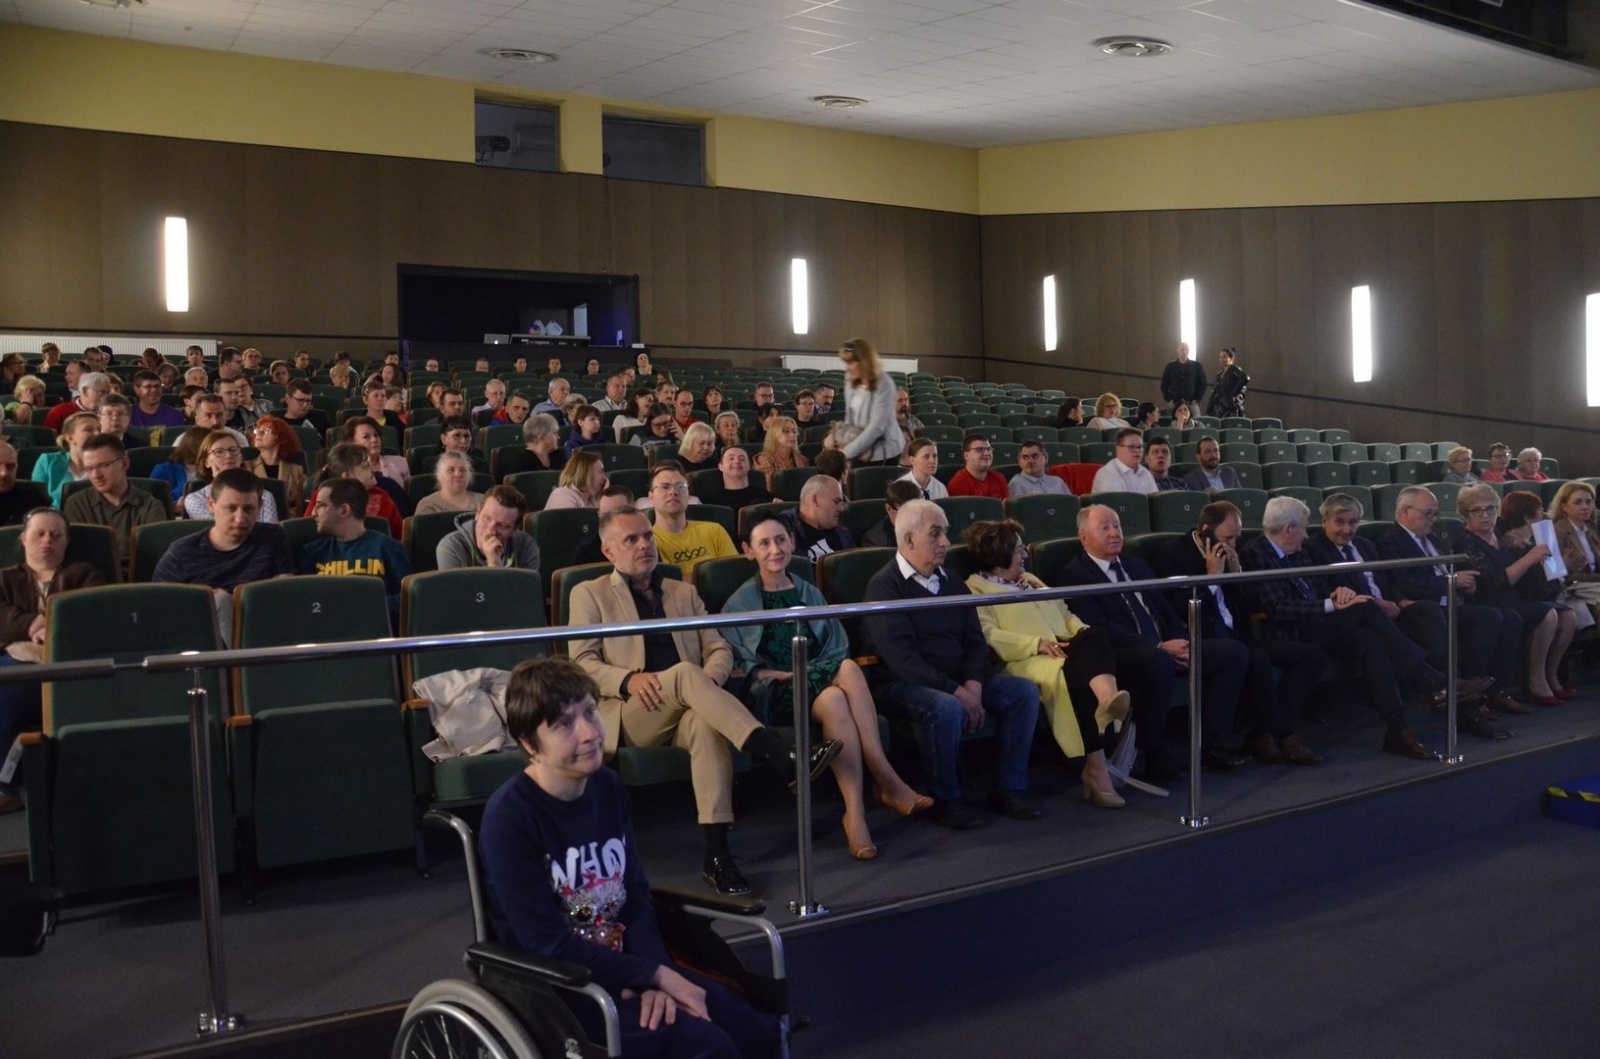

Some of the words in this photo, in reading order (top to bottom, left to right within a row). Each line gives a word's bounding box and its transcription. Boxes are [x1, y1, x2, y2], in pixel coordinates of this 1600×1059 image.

[583, 524, 589, 533] 5
[475, 592, 485, 603] 3
[312, 602, 321, 613] 2
[130, 612, 137, 623] 1
